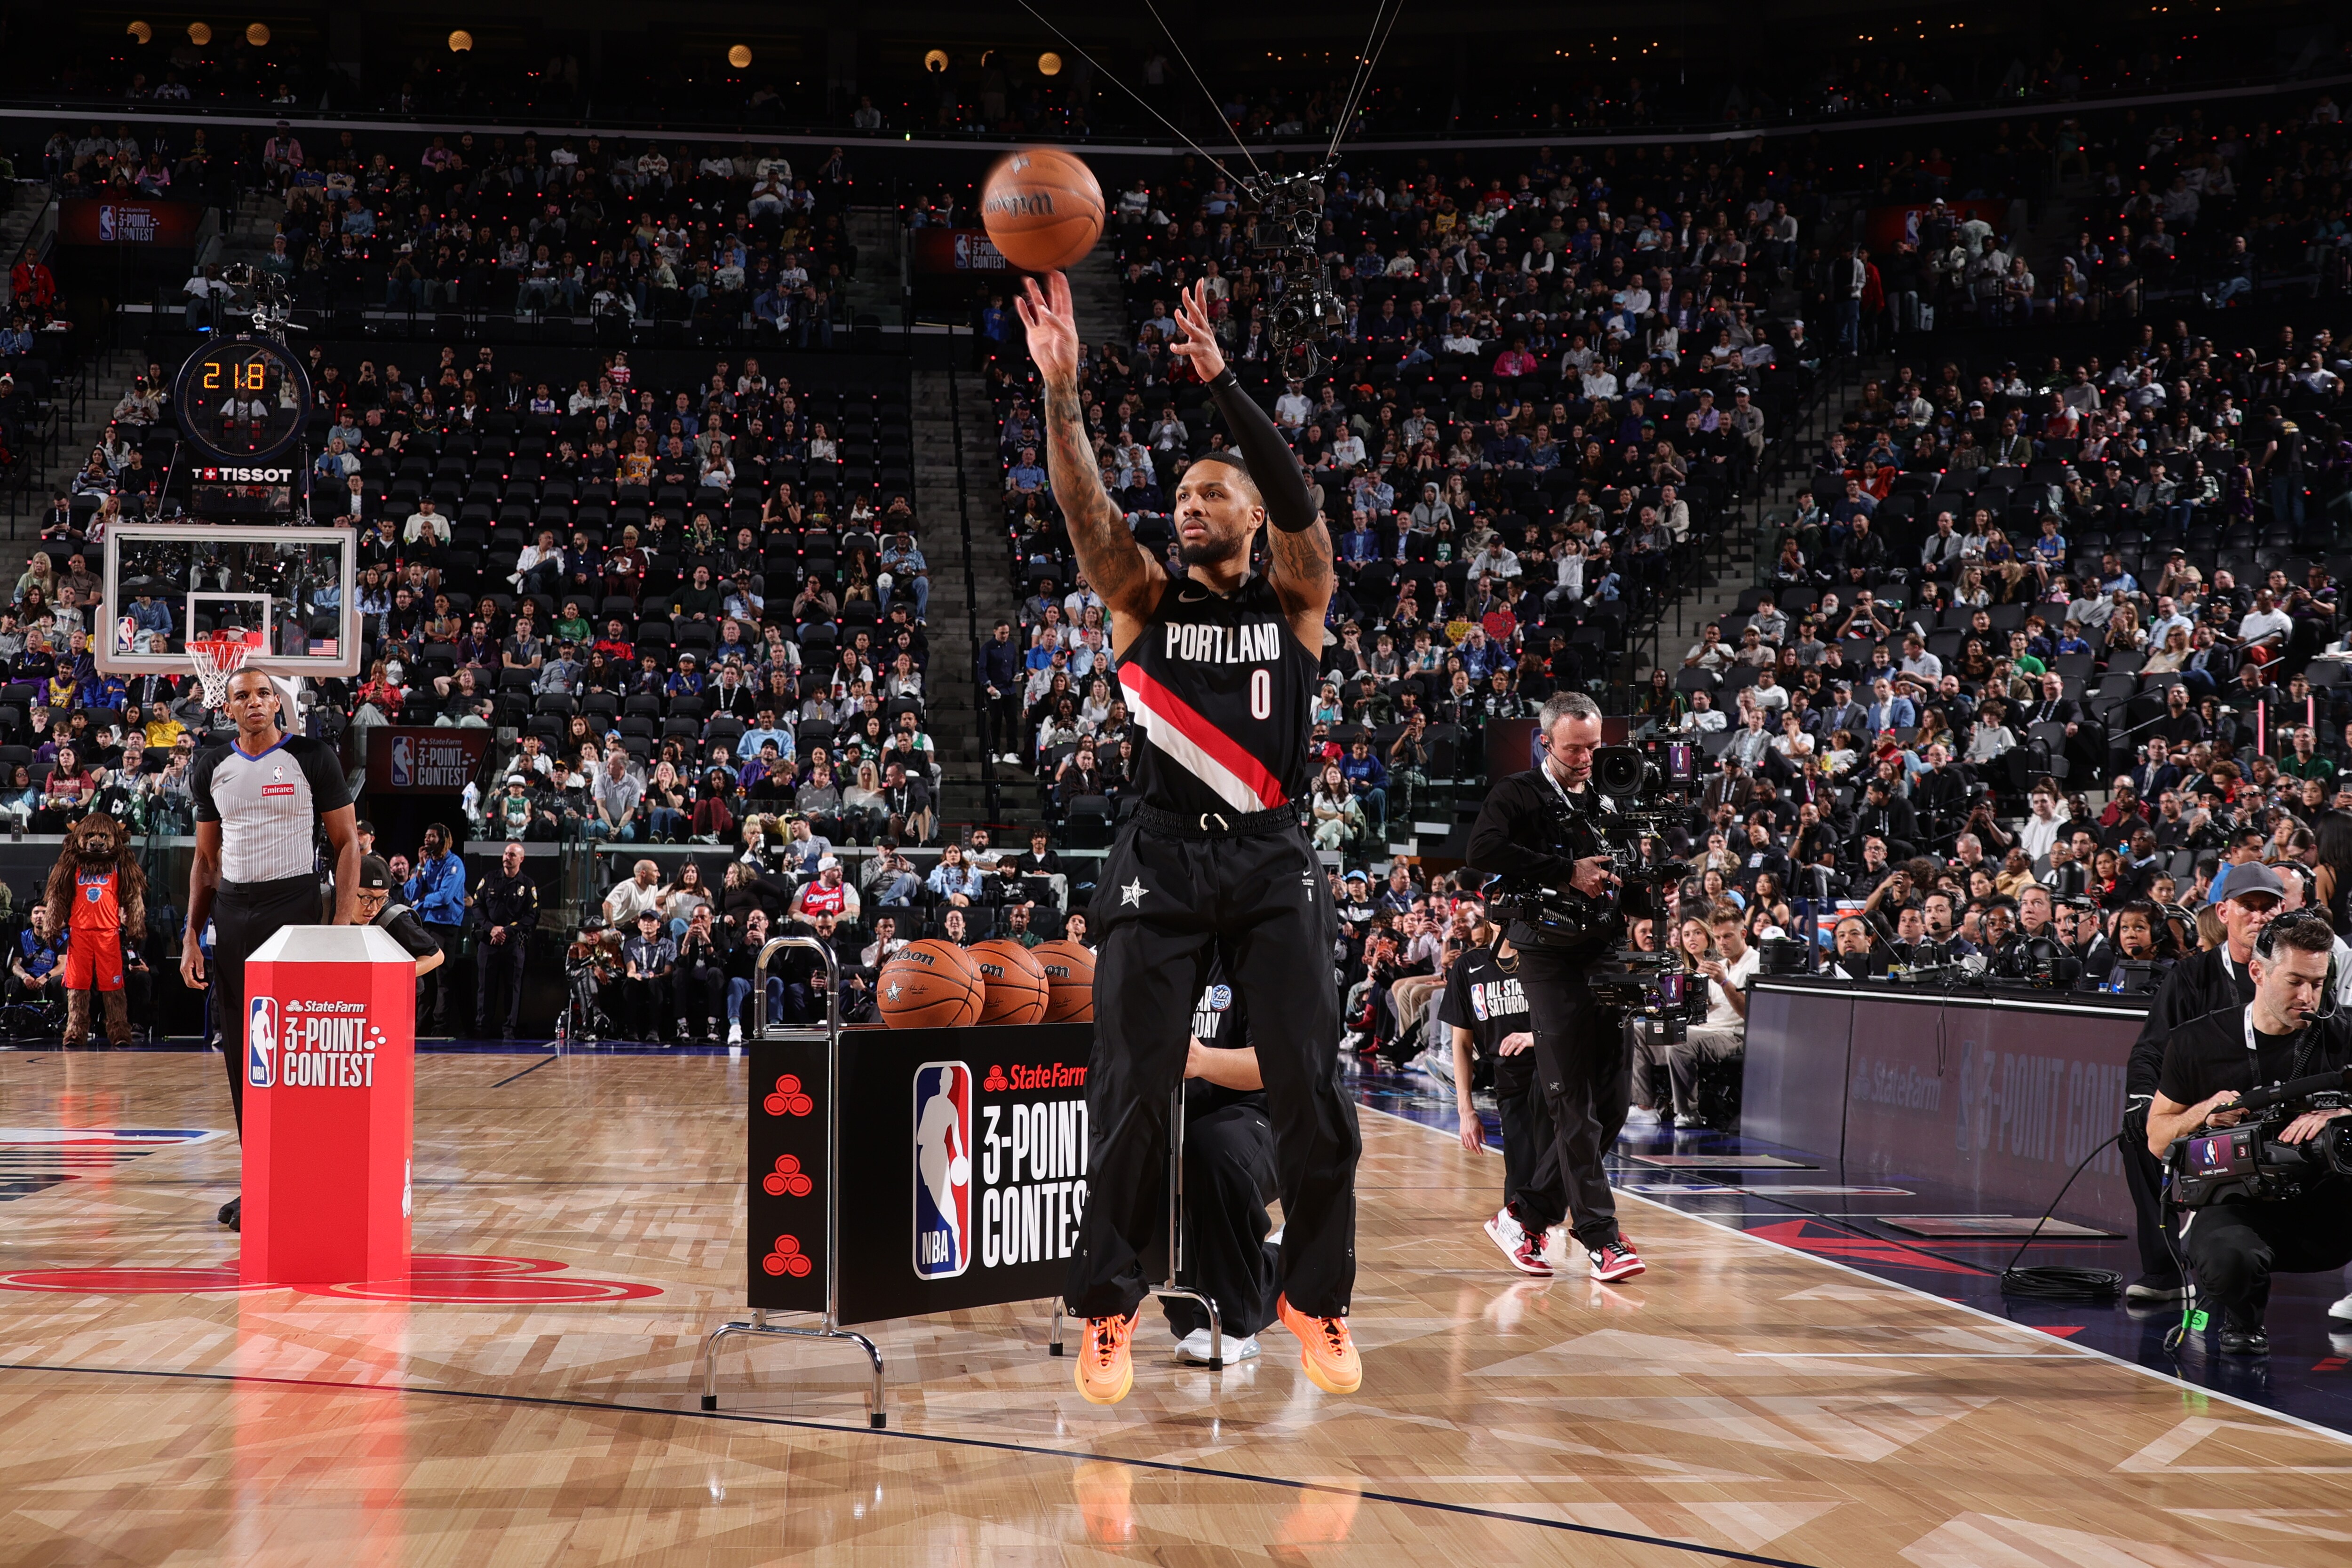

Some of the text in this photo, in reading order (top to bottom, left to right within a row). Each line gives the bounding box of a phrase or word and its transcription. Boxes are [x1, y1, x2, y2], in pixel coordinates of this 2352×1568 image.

[119, 214, 151, 227] 3-POINT
[119, 228, 154, 241] CONTEST
[219, 467, 292, 483] TISSOT
[1165, 621, 1280, 664] PORTLAND
[1251, 669, 1271, 720] 0
[419, 747, 462, 766] 3-POINT
[418, 767, 468, 786] CONTEST
[262, 786, 294, 795] Emirates
[806, 893, 840, 904] Clippers
[826, 901, 839, 911] 21
[303, 1001, 367, 1013] StateFarm
[284, 1017, 366, 1052] 3-POINT
[252, 1066, 265, 1081] NBA
[283, 1052, 375, 1087] CONTEST
[1978, 1050, 2065, 1161] 3-POINT
[982, 1100, 1088, 1186] 3-POINT
[922, 1229, 949, 1265] NBA
